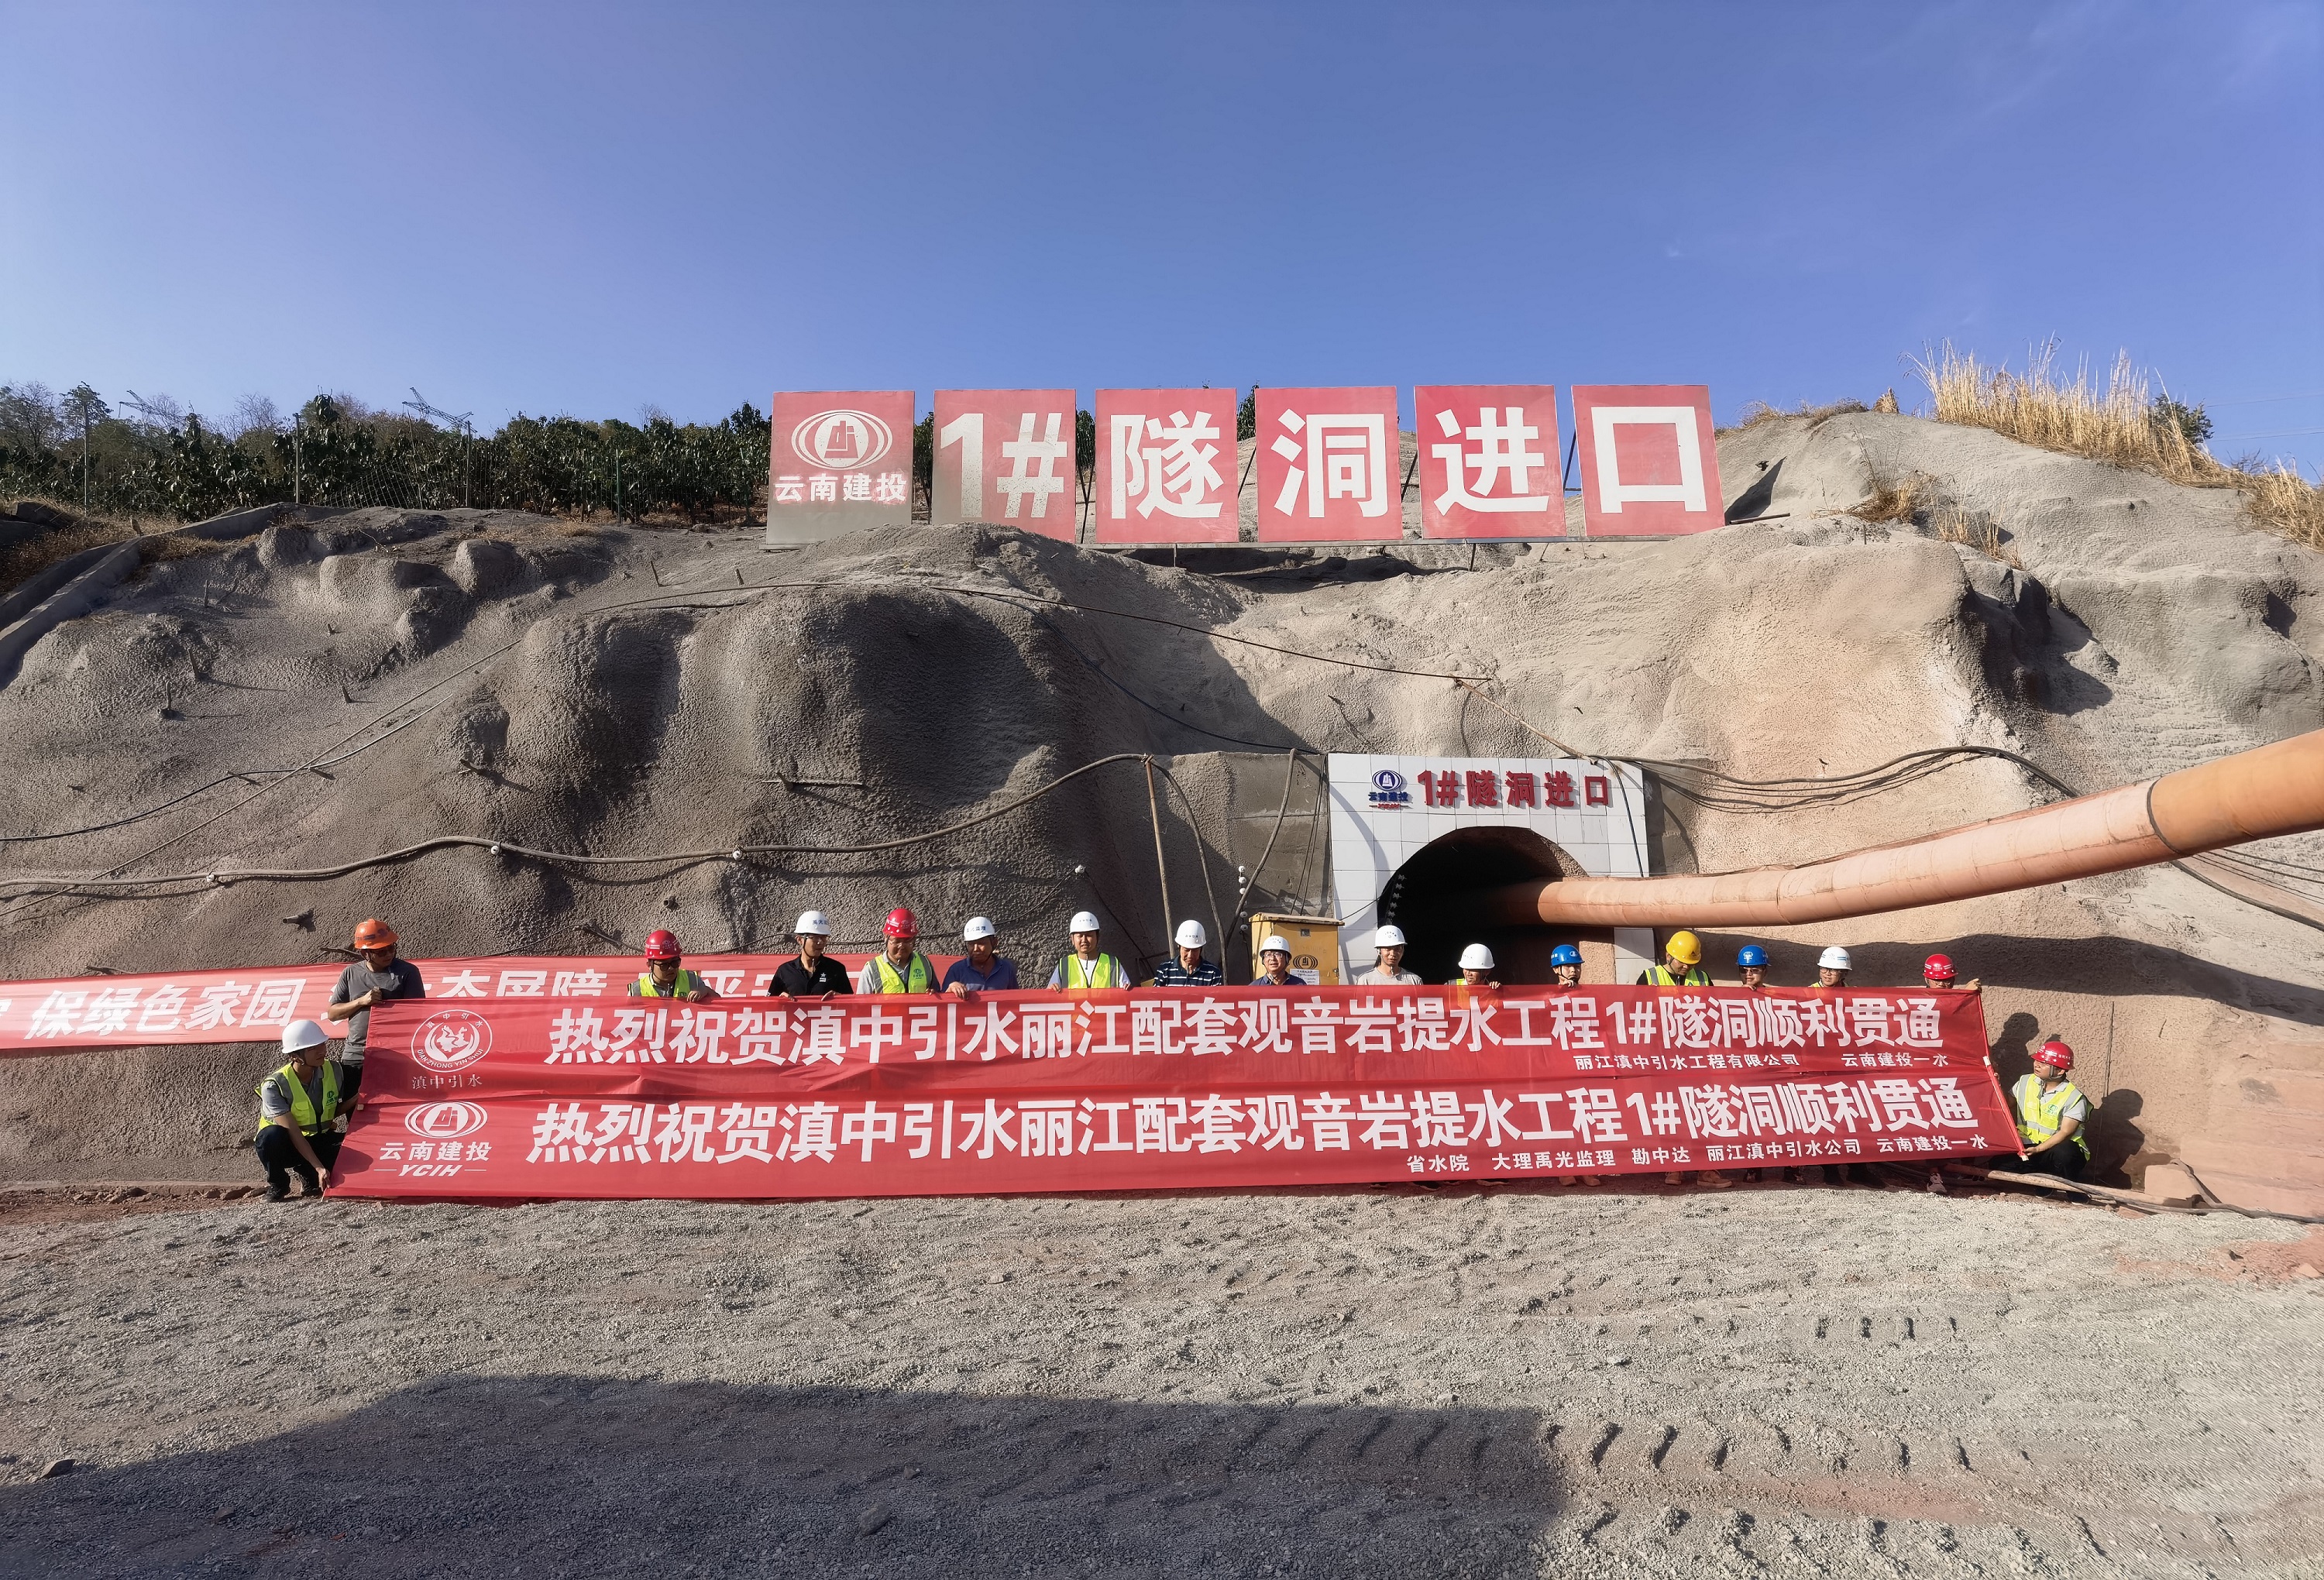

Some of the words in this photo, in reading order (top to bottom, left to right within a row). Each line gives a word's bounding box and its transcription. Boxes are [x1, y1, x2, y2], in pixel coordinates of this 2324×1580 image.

[938, 405, 1708, 520] 1#隧洞进口
[775, 472, 906, 502] 云南建投
[1417, 770, 1609, 807] 1#隧洞进口
[23, 978, 307, 1040] 保绿色家园
[543, 995, 1944, 1066] 热烈祝贺滇中引水丽江配套观音岩提水工程1#隧洞顺利贯通
[1573, 1054, 1800, 1071] 丽江滇中引水工程有限公司
[1841, 1052, 1949, 1067] 云南建投一水
[412, 1073, 483, 1090] 滇中引水
[525, 1077, 1979, 1164] 热烈祝贺滇中引水丽江配套观音岩提水工程1#隧洞顺利贯通
[379, 1141, 492, 1162] 云南建投
[398, 1164, 462, 1176] YCIH
[1407, 1154, 1470, 1173] 省水院
[1491, 1149, 1616, 1170] 大理禹光监理
[1631, 1147, 1691, 1165] 勘中达
[1706, 1139, 1861, 1162] 丽江滇中引水公司
[1876, 1134, 1989, 1152] 云南建投一水
